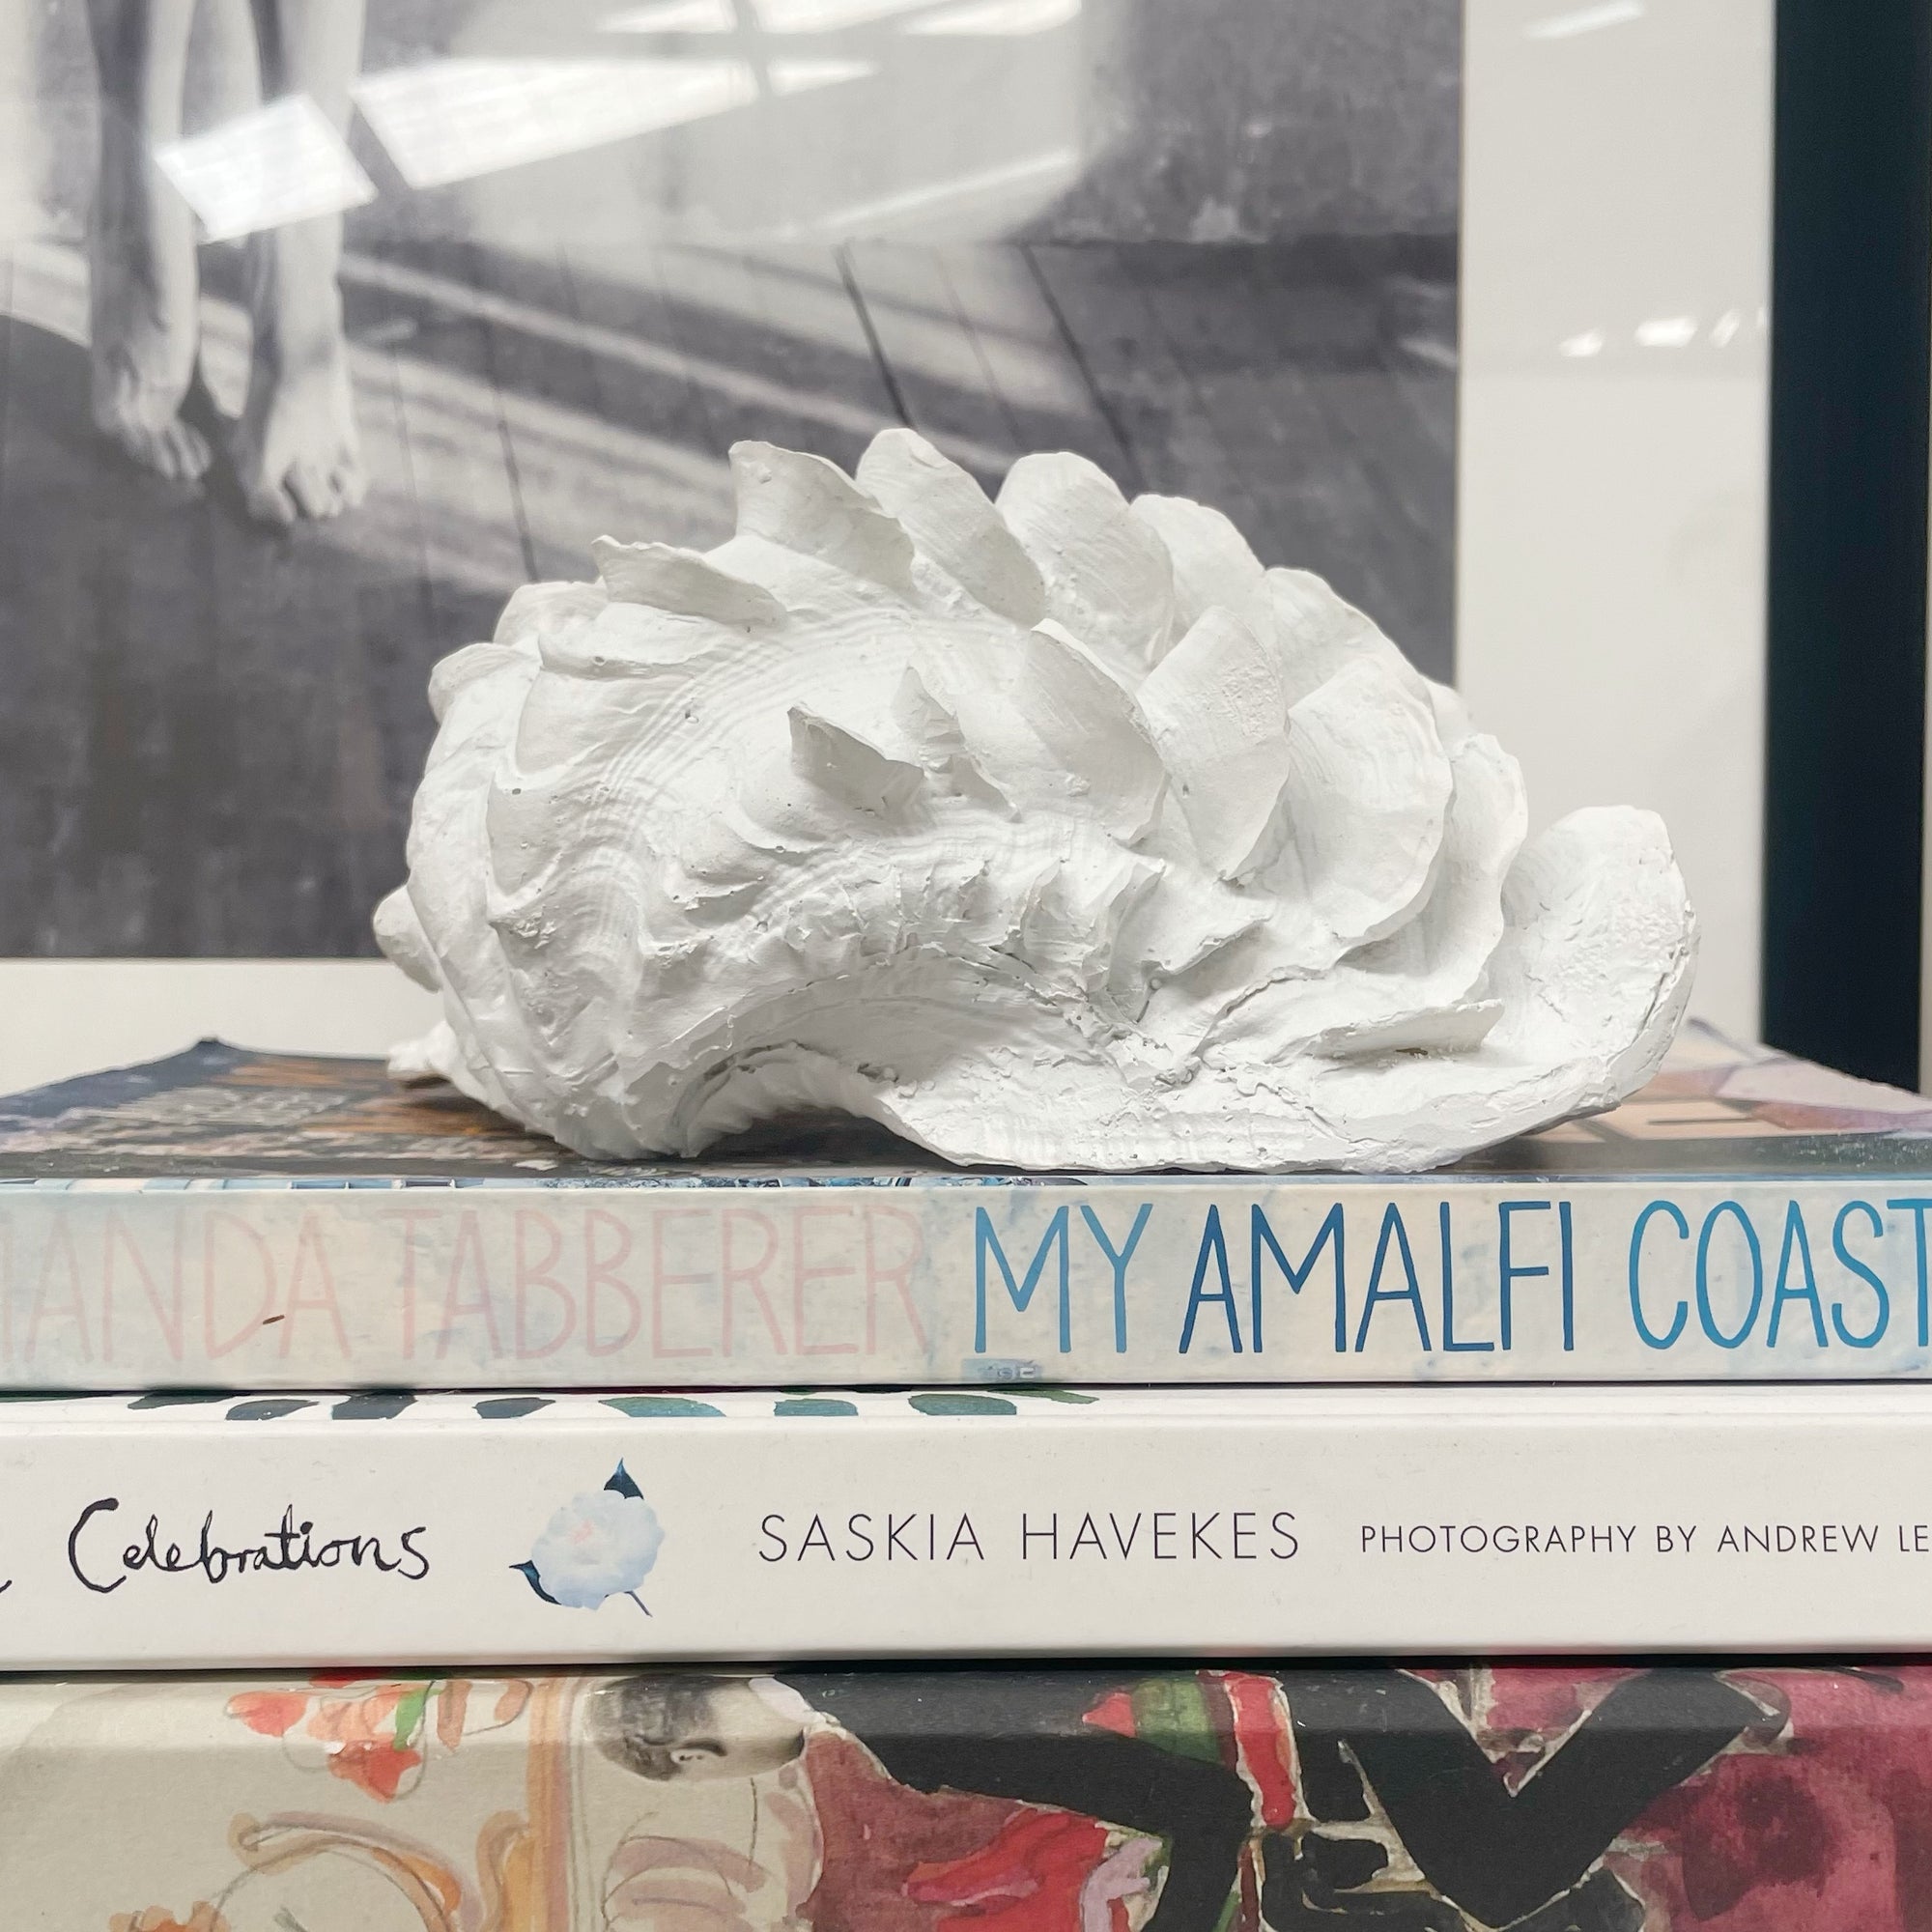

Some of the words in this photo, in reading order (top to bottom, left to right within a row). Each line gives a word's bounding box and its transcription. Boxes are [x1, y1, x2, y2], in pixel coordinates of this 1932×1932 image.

[0, 1208, 353, 1362] ANDA
[377, 1205, 926, 1360] TABBERER
[975, 1203, 1151, 1353] MY
[1179, 1200, 1575, 1353] AMALFI
[1628, 1198, 1932, 1350] COAST
[68, 1497, 430, 1594] Celebrations
[758, 1512, 985, 1563] SASKIA
[1022, 1511, 1299, 1562] HAVEKES
[1361, 1523, 1636, 1553] PHOTOGRAPHY
[1656, 1523, 1697, 1553] BY
[1717, 1523, 1879, 1553] ANDREW
